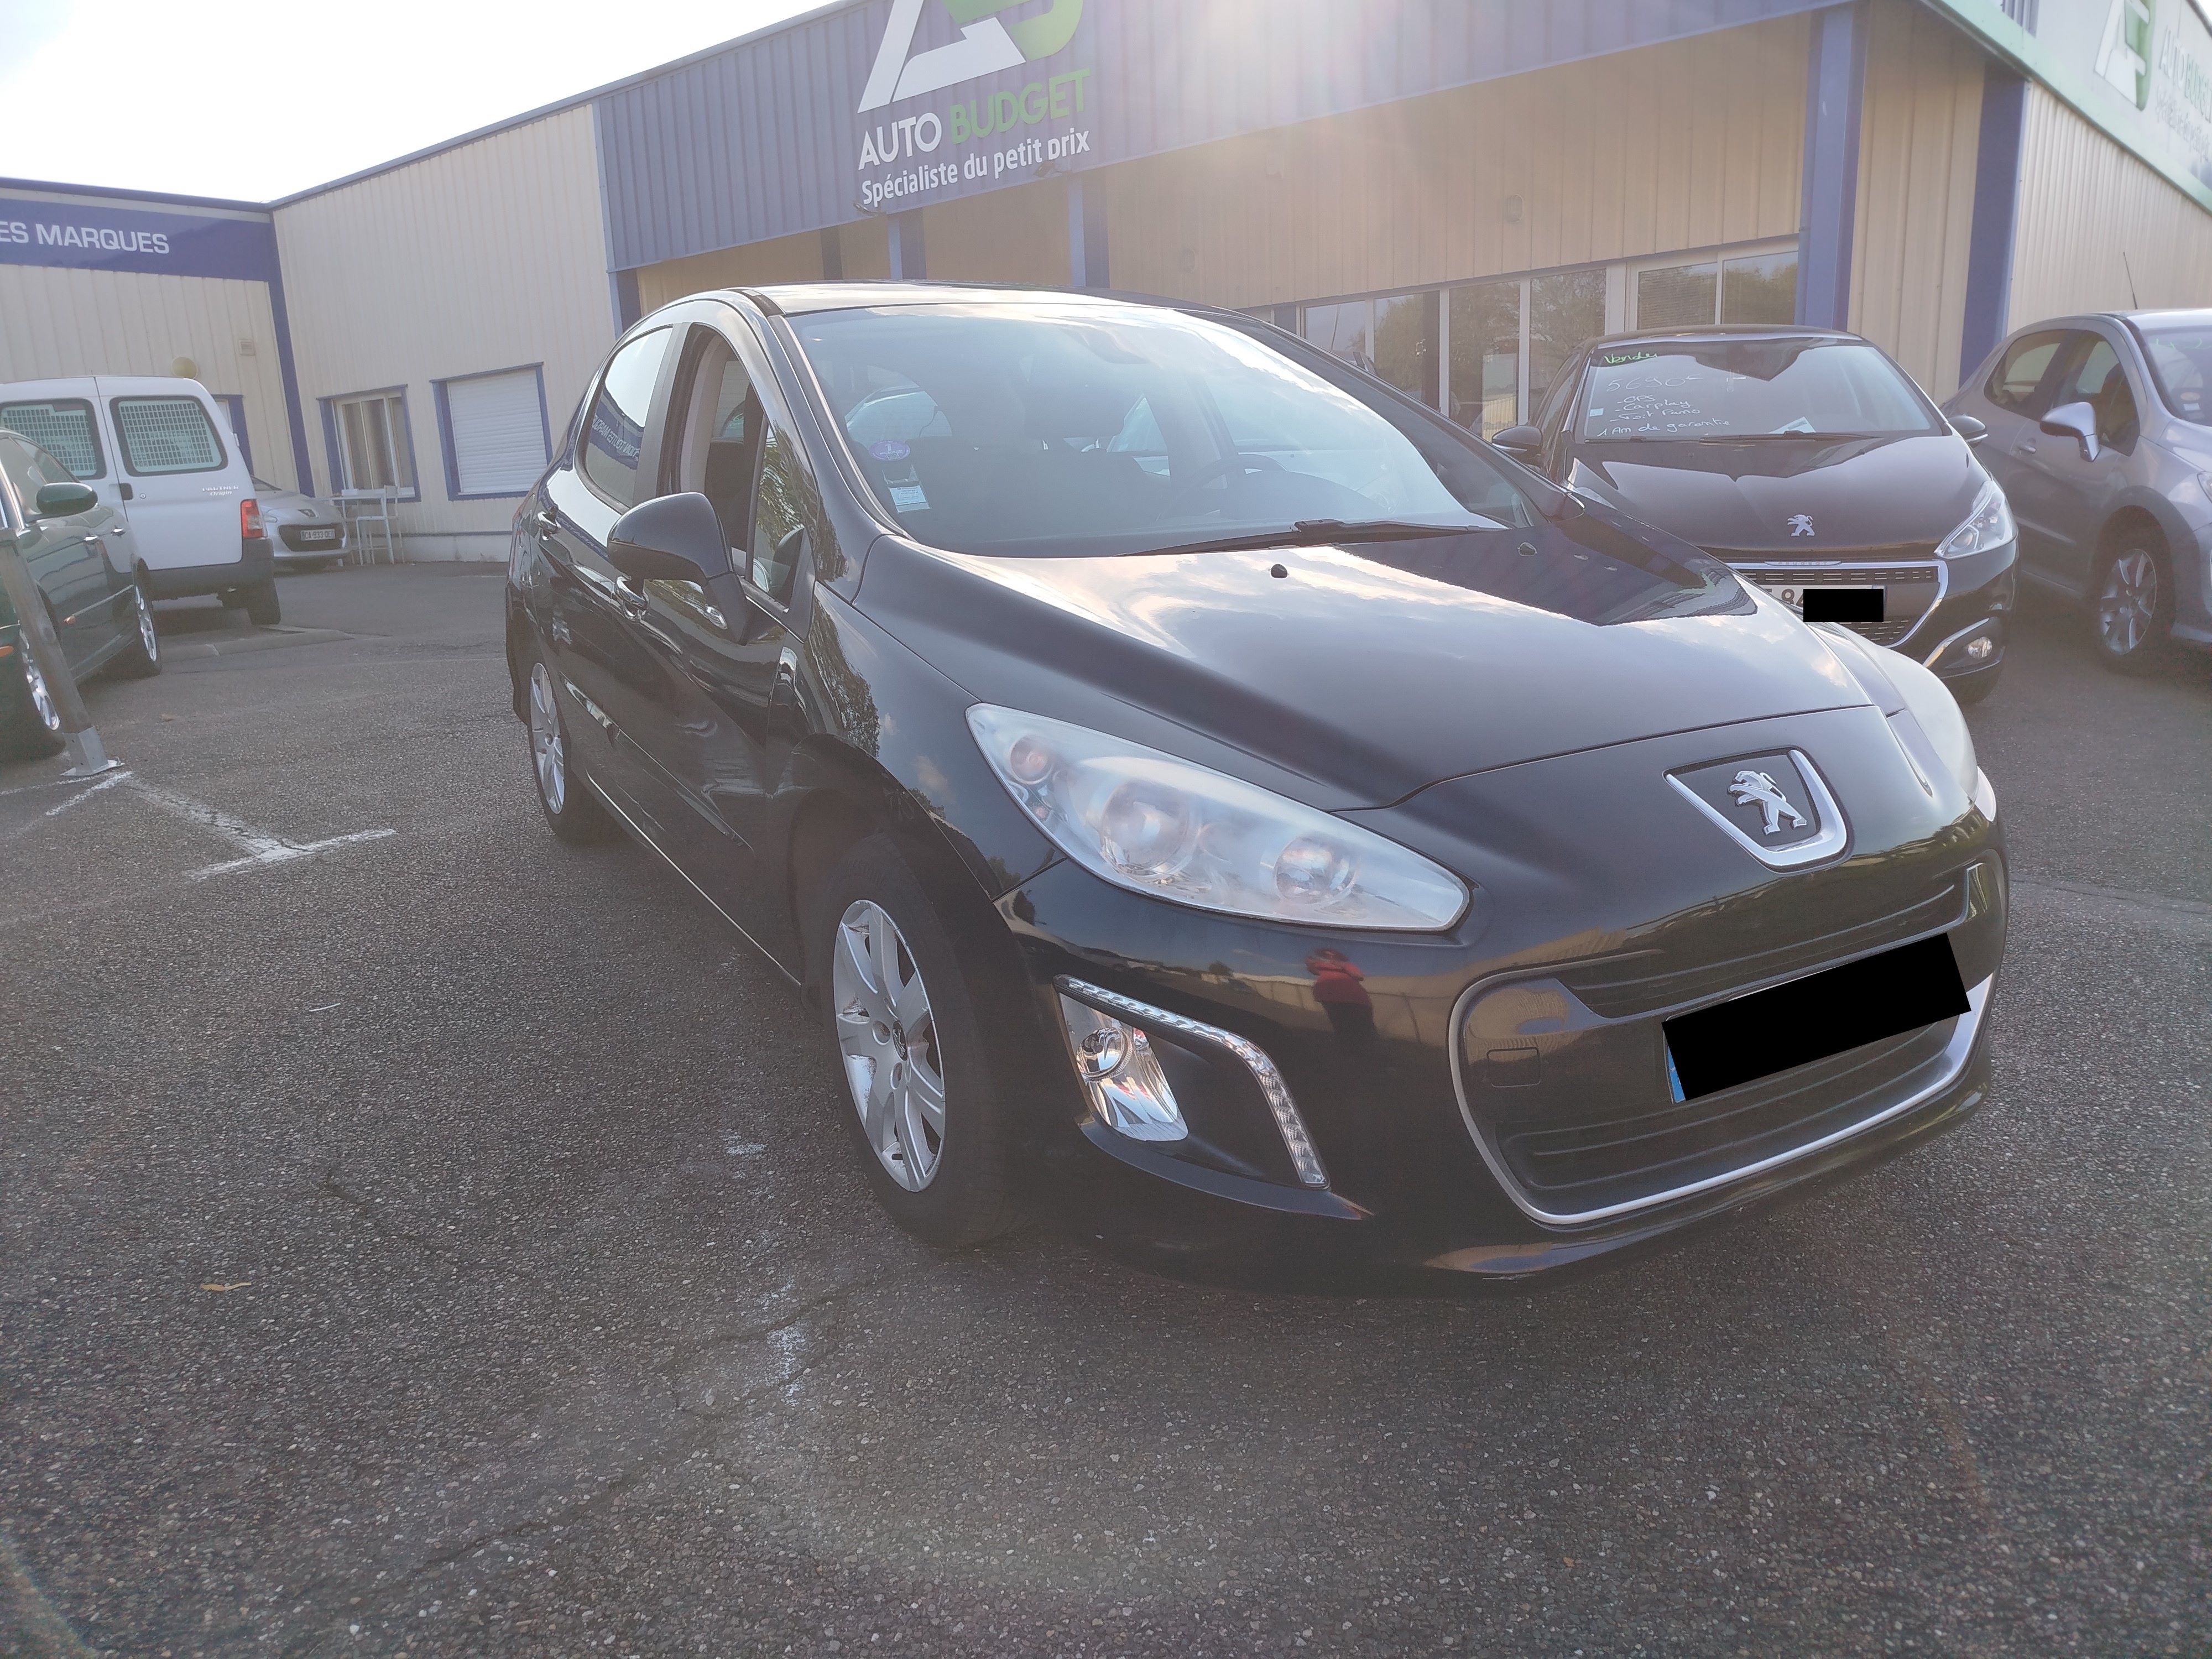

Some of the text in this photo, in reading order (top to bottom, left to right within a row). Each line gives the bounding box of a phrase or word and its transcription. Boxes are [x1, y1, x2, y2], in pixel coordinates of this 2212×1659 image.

[858, 67, 1091, 170] AUTO BUDGET
[862, 163, 958, 207] Spécialiste
[964, 153, 988, 180] du
[994, 139, 1043, 179] petit
[35, 223, 170, 254] MARQUES
